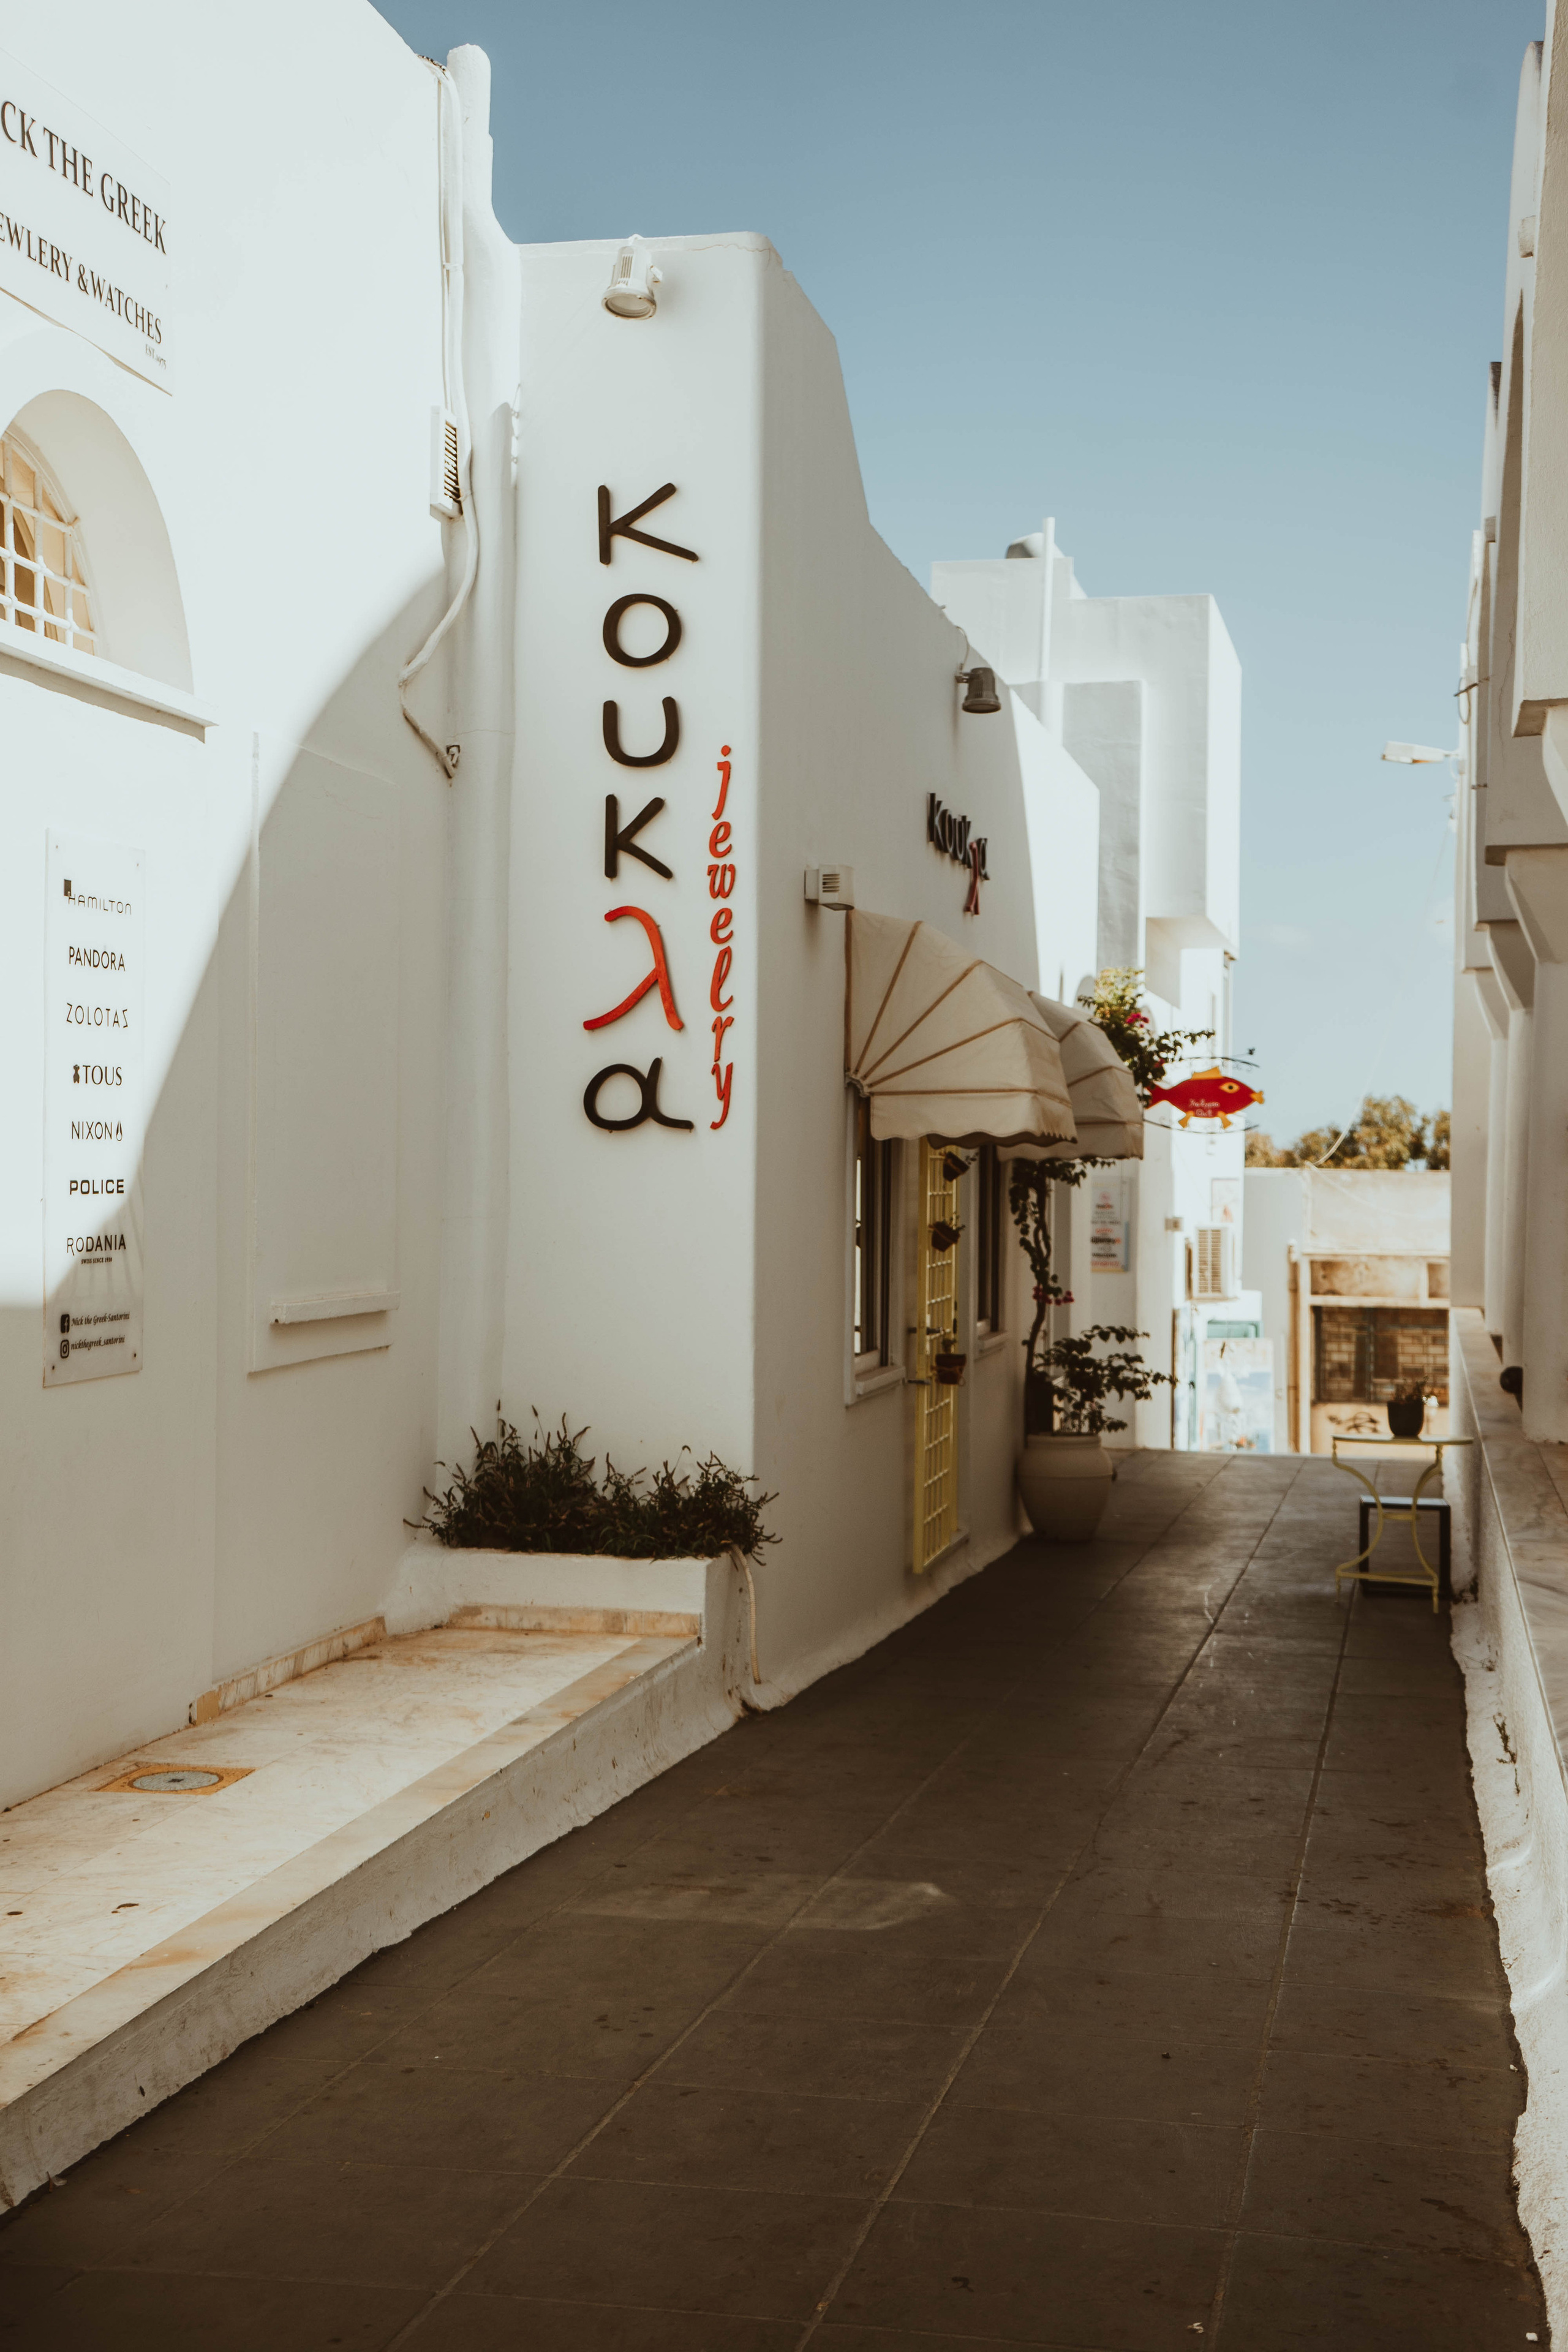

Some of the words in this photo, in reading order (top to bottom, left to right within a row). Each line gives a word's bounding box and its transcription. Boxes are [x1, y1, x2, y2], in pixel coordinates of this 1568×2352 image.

[1, 100, 38, 158] CK
[43, 126, 94, 197] THE
[100, 173, 167, 255] GREEK
[67, 891, 132, 916] HAMILTON
[707, 745, 736, 1130] jewelry
[69, 946, 126, 972] PANDORA
[66, 1003, 129, 1028] ZOLOTAS
[83, 1065, 123, 1086] TOUS
[72, 1121, 113, 1140] NIXON
[69, 1179, 124, 1195] POLICE
[67, 1234, 126, 1256] RODANIA
[71, 1316, 84, 1326] Nick
[71, 1335, 126, 1351] nickthegreek_santorini
